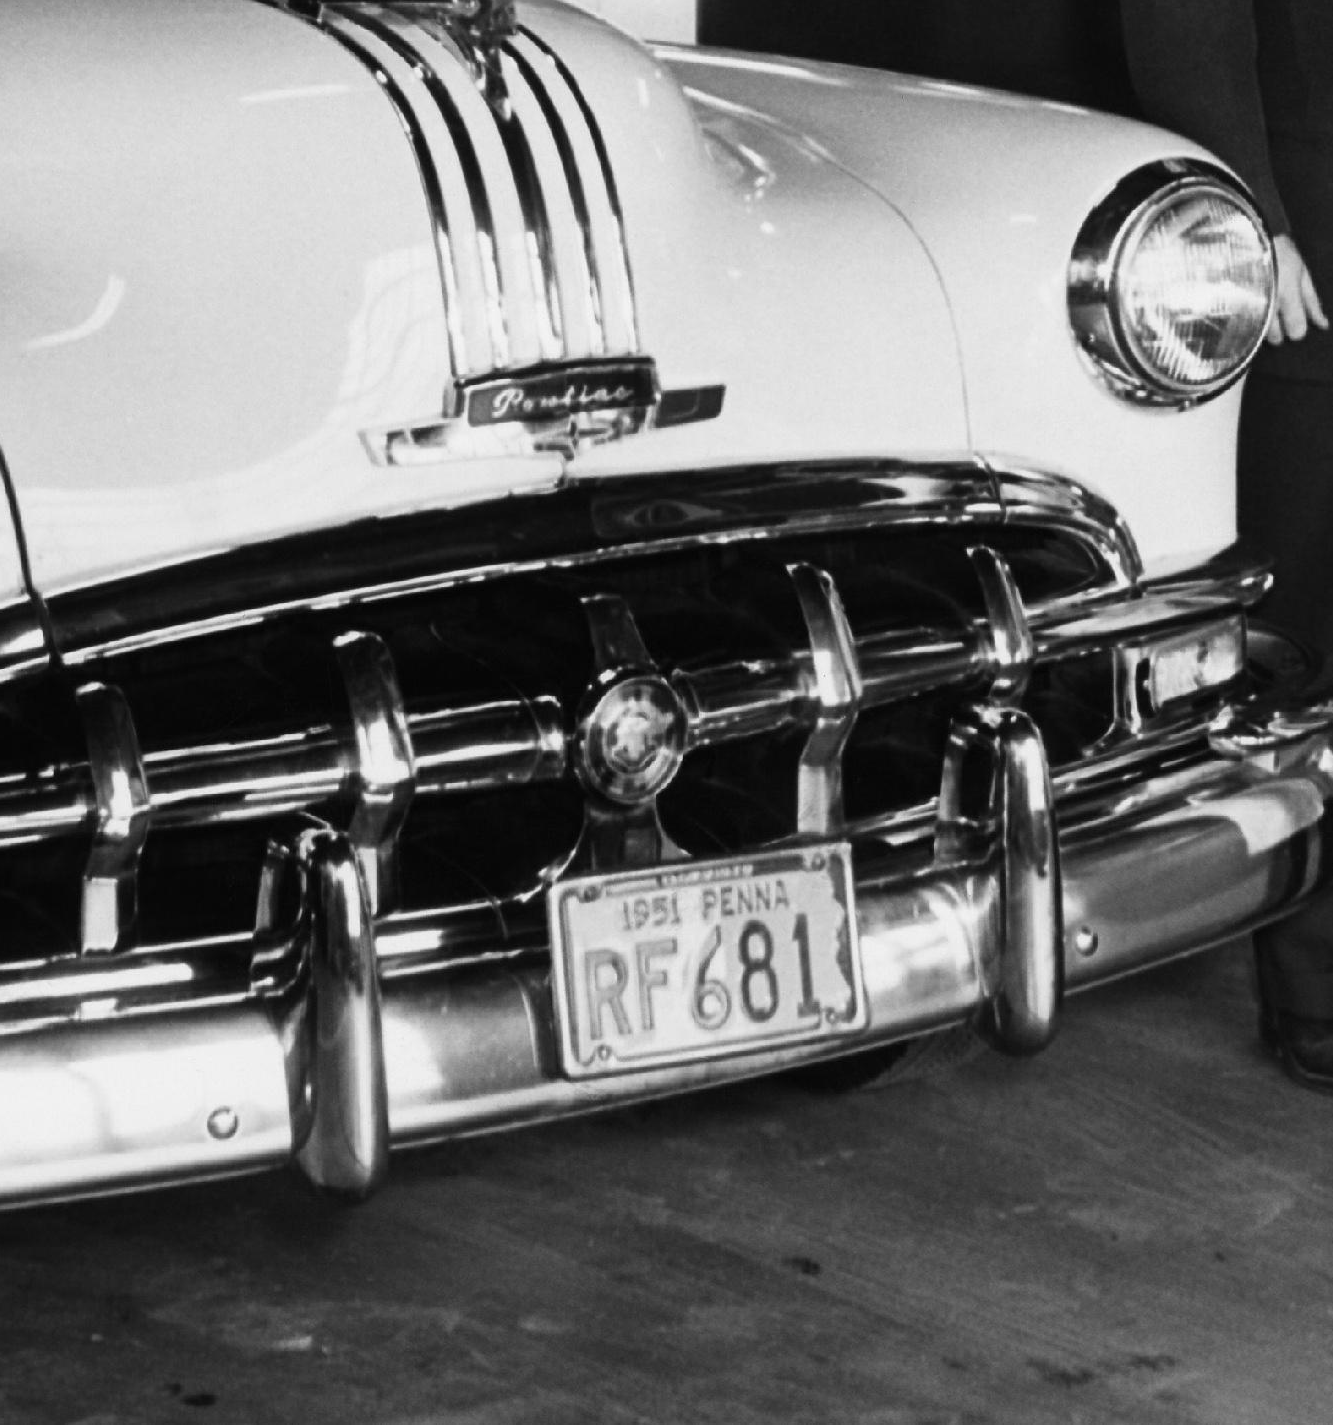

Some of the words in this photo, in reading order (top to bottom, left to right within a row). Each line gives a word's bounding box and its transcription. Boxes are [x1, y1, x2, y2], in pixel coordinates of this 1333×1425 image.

[621, 891, 683, 931] 1951
[699, 879, 792, 924] PENNA
[582, 912, 822, 1041] RF681
